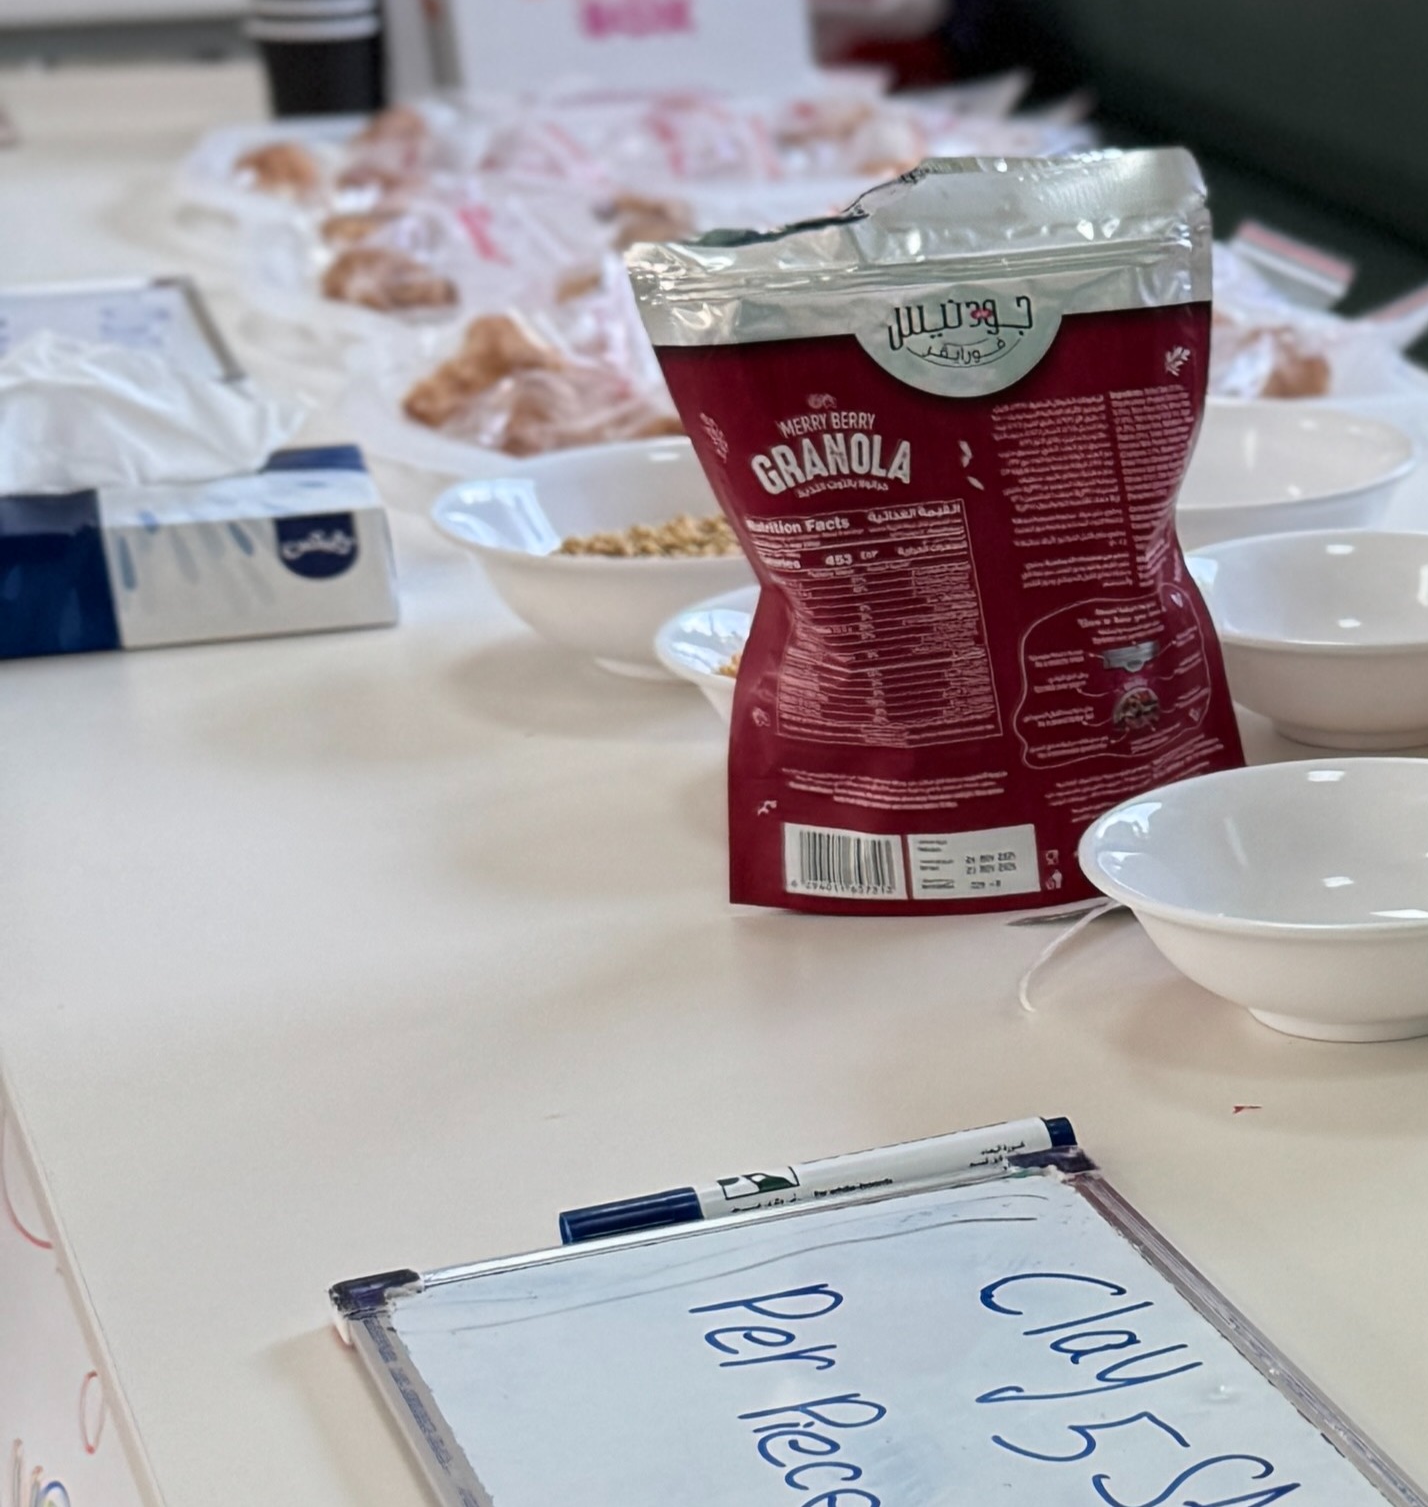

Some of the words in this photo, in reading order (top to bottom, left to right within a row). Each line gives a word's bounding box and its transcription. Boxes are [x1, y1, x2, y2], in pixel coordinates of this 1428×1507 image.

[777, 413, 828, 439] MERRY
[830, 411, 876, 431] BERRY
[750, 432, 911, 495] GRANOLA
[805, 516, 850, 532] Facts
[687, 1283, 844, 1371] Per
[975, 1272, 1204, 1404] Clay
[991, 1411, 1191, 1463] 5
